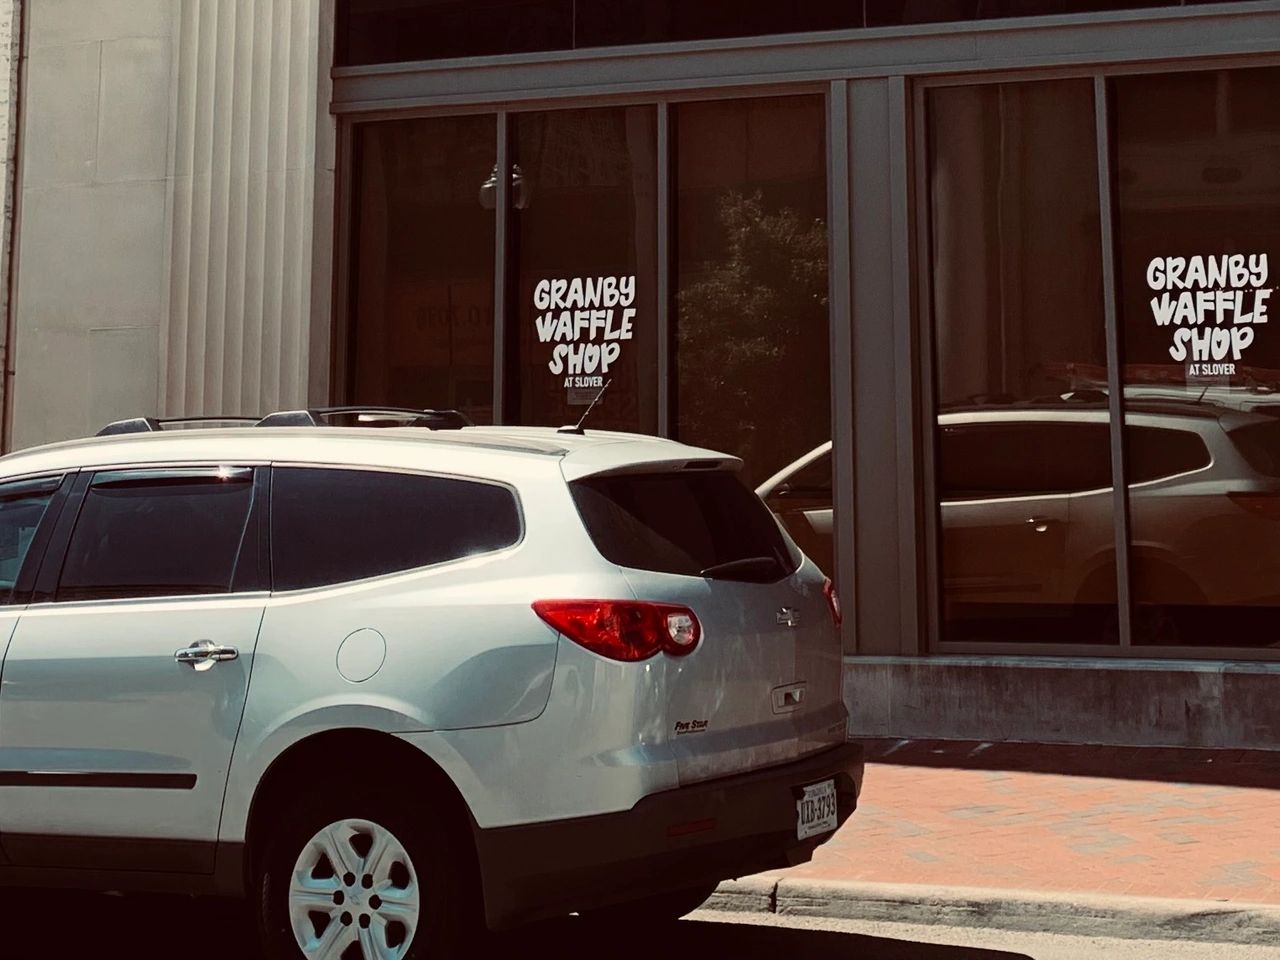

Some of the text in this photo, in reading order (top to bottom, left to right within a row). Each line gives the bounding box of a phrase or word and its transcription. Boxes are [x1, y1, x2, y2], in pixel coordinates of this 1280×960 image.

[1146, 253, 1269, 290] GRANBY
[533, 275, 636, 310] GRANBY
[1150, 289, 1272, 326] WAFFLE
[535, 308, 637, 343] WAFFLE
[548, 342, 621, 375] SHOP
[1168, 326, 1255, 362] SHOP
[563, 376, 603, 388] AT SLOVER
[1188, 363, 1236, 376] AT SLOVER
